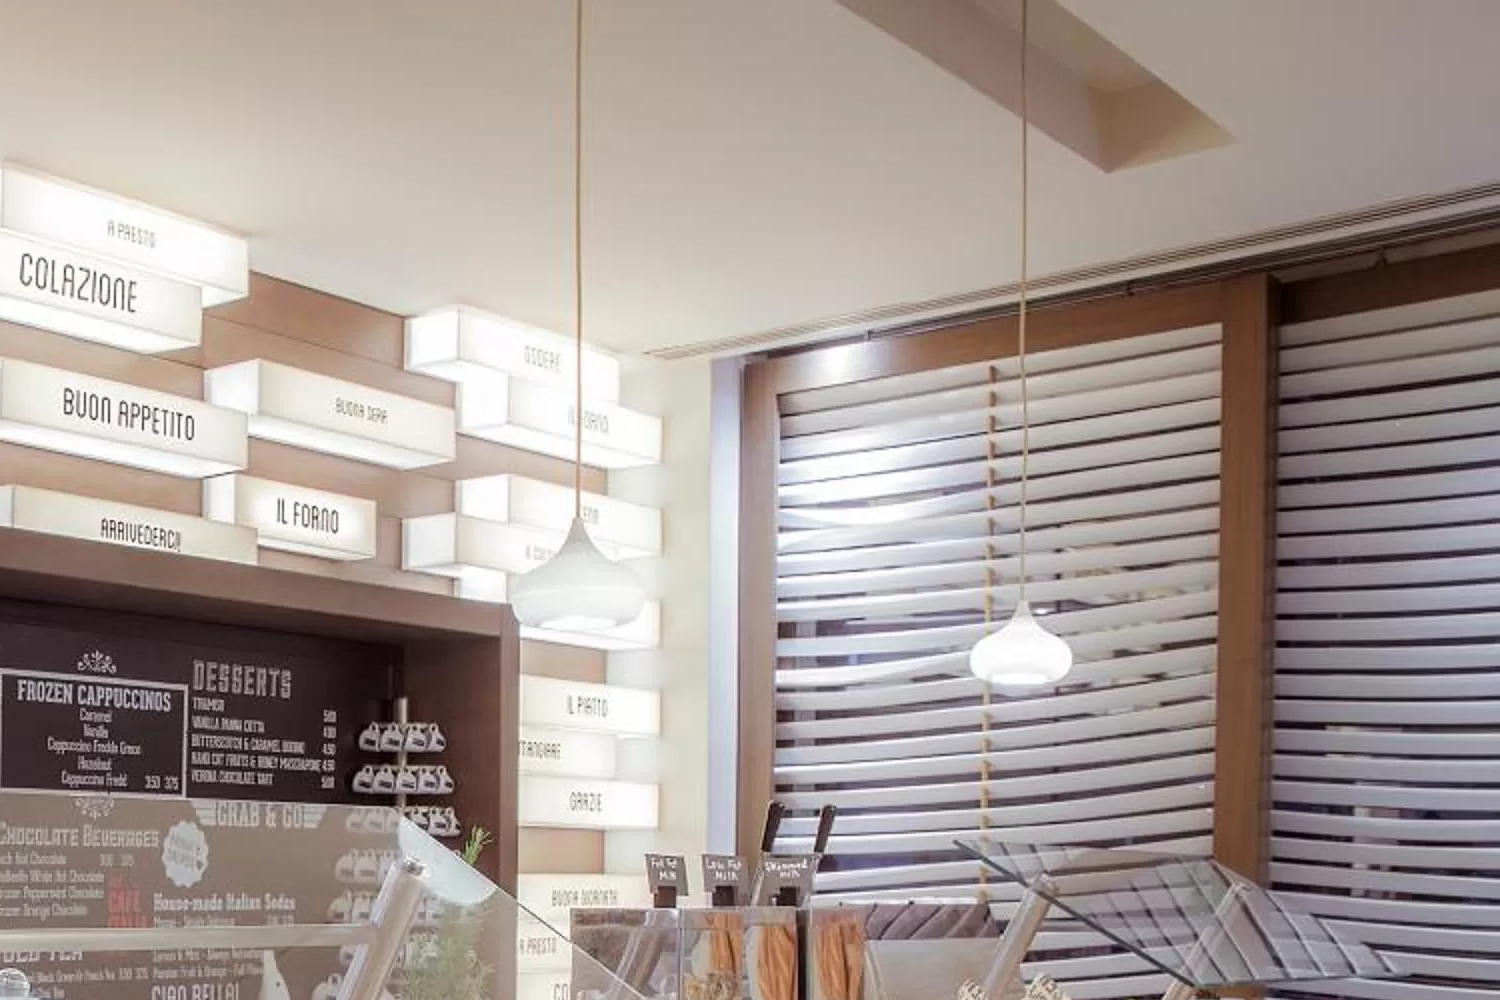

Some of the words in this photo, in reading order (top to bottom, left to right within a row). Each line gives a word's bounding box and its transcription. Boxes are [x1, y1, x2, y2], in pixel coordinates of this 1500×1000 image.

[19, 253, 137, 313] COLAZIONE
[63, 387, 111, 425] BUON
[118, 399, 195, 441] APPETITO
[276, 497, 288, 525] IL
[294, 501, 339, 534] FORNO
[192, 658, 293, 699] DESSERTS
[17, 679, 73, 705] FROZEN
[77, 683, 171, 713] CAPPUCCINOS
[566, 694, 575, 715] IL
[216, 802, 260, 828] GRAB
[266, 803, 277, 829] &
[283, 804, 304, 829] GO
[569, 791, 602, 812] GRAZIE
[83, 823, 160, 849] BEVERAGES
